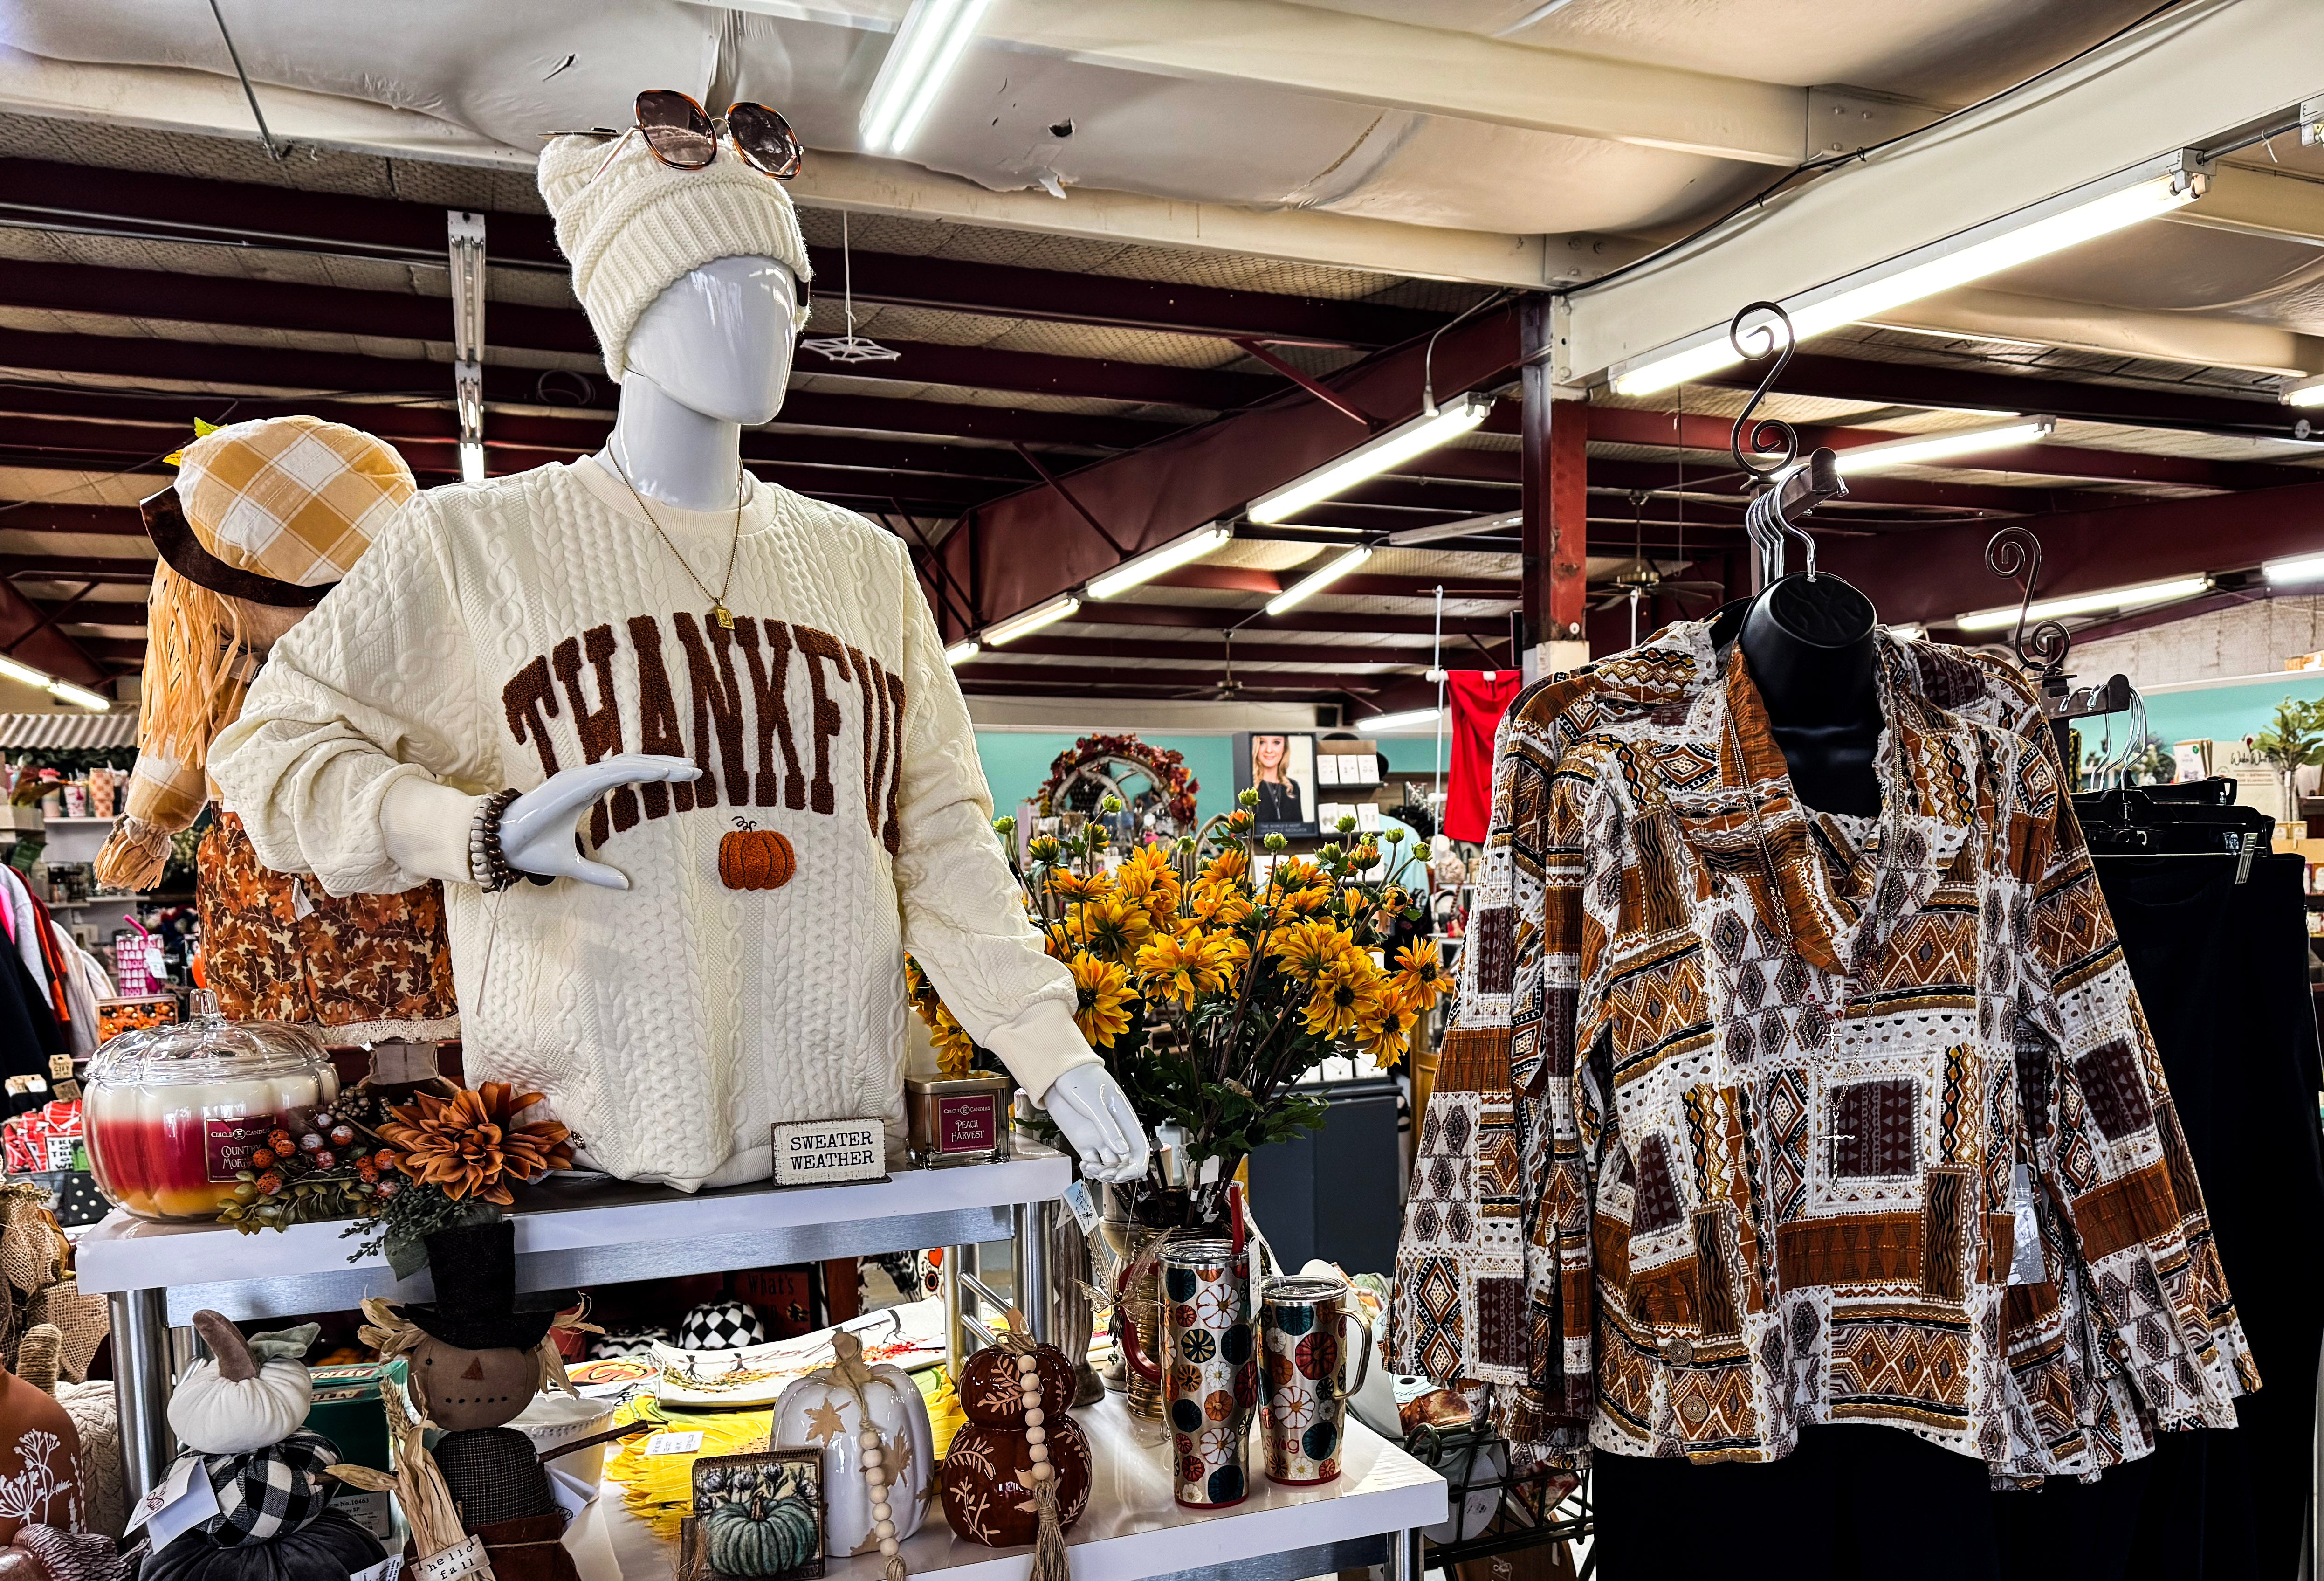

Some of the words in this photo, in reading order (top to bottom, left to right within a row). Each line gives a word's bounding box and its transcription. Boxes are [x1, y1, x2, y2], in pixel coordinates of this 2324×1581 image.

[955, 1120, 978, 1131] PEACH
[791, 1131, 873, 1151] SWEATER
[952, 1130, 984, 1142] HARVEST
[221, 1145, 261, 1158] COUNTRY
[790, 1150, 874, 1170] WEATHER
[747, 1273, 794, 1295] What's
[310, 1369, 375, 1379] ATTRA
[311, 1389, 360, 1401] ATTR
[1266, 1435, 1300, 1454] swig
[427, 1546, 473, 1572] hello
[440, 1558, 474, 1580] fall
